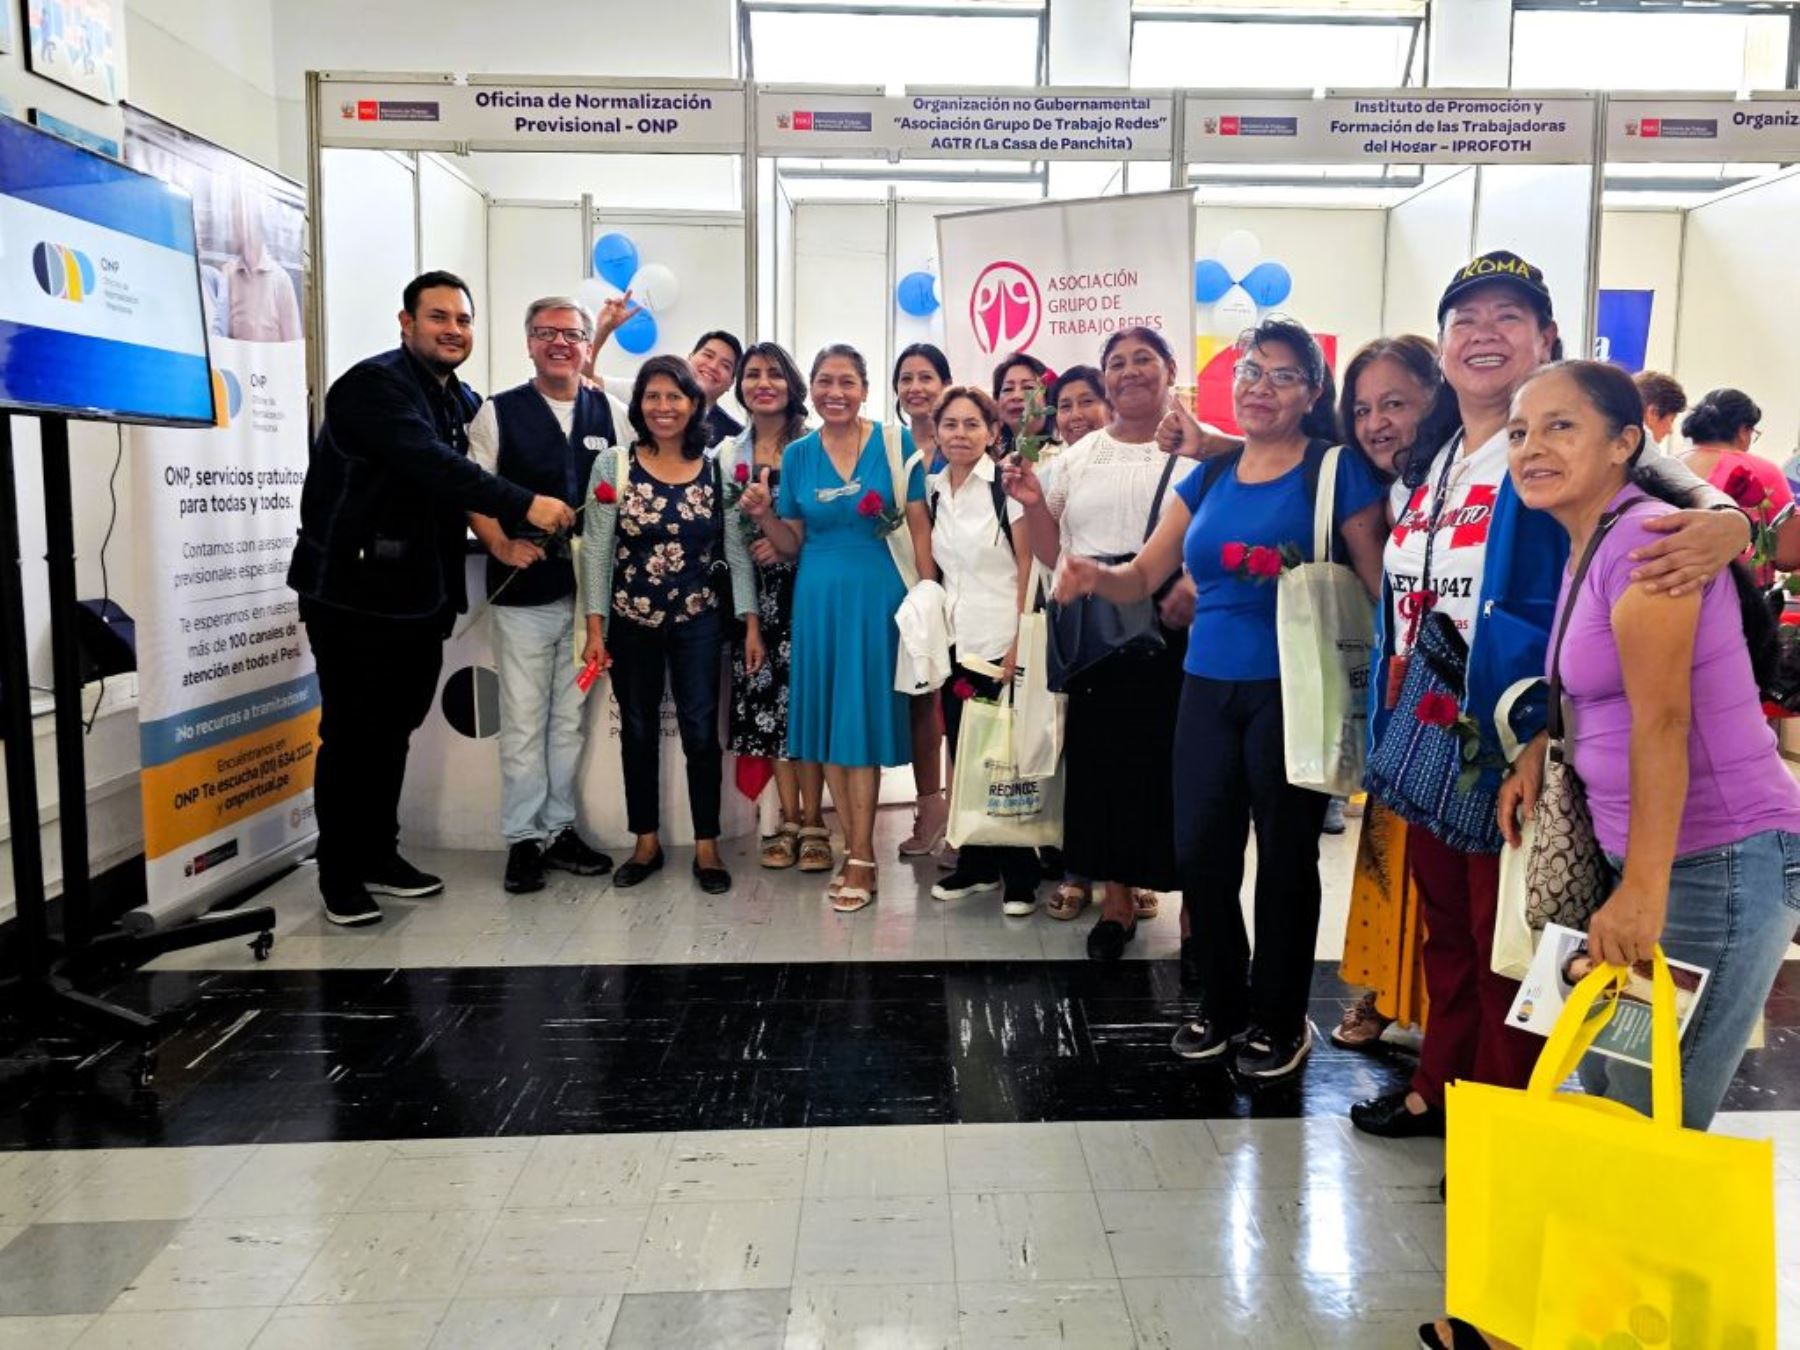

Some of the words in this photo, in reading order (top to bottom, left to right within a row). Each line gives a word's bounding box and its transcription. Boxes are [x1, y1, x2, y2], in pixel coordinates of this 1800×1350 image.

[475, 91, 544, 108] Oficina
[548, 93, 572, 108] de
[575, 93, 712, 110] Normalización
[913, 96, 1010, 113] Organización
[1013, 100, 1031, 111] no
[1034, 98, 1151, 111] Gubernamental
[1355, 100, 1422, 113] Instituto
[1425, 100, 1444, 113] de
[1448, 100, 1530, 113] Promoción
[1534, 102, 1543, 115] y
[515, 116, 621, 133] Previsional
[637, 118, 678, 133] ONP
[983, 118, 1031, 133] Grupo
[1033, 118, 1052, 130] De
[1055, 116, 1112, 133] Trabajo
[1330, 119, 1412, 133] Formación
[1415, 120, 1434, 133] de
[1438, 120, 1459, 133] las
[1462, 119, 1566, 135] Trabajadoras
[1733, 110, 1800, 130] Organiz
[931, 137, 972, 149] AGTR
[975, 137, 999, 150] (La
[1002, 138, 1037, 150] Casa
[1040, 137, 1058, 150] de
[1061, 136, 1133, 151] Panchita)
[1363, 140, 1387, 152] del
[1391, 140, 1437, 153] Hogar
[1452, 140, 1531, 151] IPROFOTH
[1462, 258, 1530, 280] ROMA
[1048, 268, 1138, 292] ASOCIACIÓN
[1048, 296, 1097, 313] GRUPO
[1102, 295, 1121, 310] DE
[1049, 317, 1115, 336] TRABAJO
[164, 465, 193, 489] ONP,
[196, 465, 254, 486] servicios
[257, 467, 304, 489] gratuitos
[180, 497, 208, 519] para
[211, 494, 246, 512] todas
[250, 496, 258, 515] y
[261, 492, 294, 511] todos.
[182, 542, 235, 560] Contamos
[236, 540, 256, 554] con
[179, 617, 191, 633] Te
[194, 608, 250, 633] esperamos
[252, 605, 267, 620] en
[187, 639, 212, 658] más
[213, 637, 228, 653] de
[229, 632, 248, 650] 100
[249, 623, 284, 646] canales
[285, 621, 297, 637] de
[182, 662, 230, 687] atención
[231, 660, 245, 675] en
[246, 653, 270, 672] todo
[271, 649, 279, 664] el
[196, 710, 242, 737] recurras
[243, 708, 251, 721] a
[175, 787, 200, 810] ONP
[202, 781, 217, 799] Te
